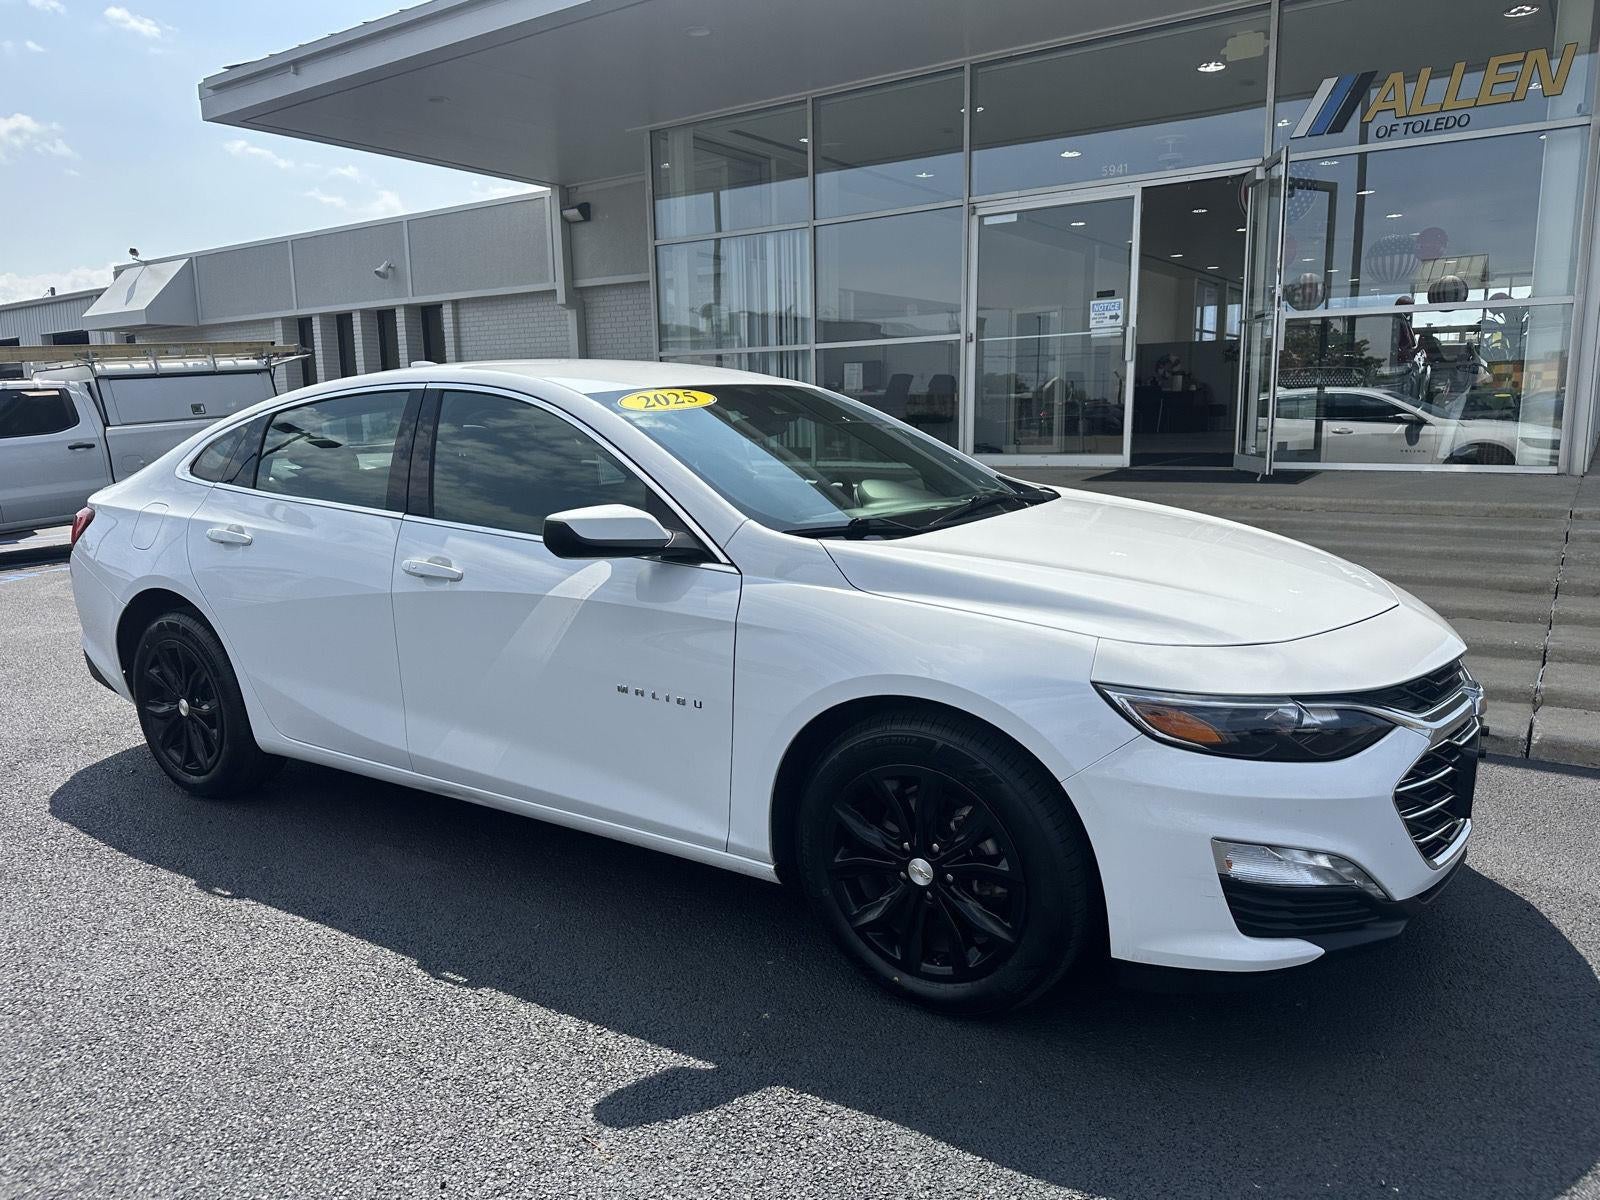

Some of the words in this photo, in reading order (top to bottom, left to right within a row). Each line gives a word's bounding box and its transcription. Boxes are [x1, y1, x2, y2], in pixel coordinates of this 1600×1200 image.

[1361, 42, 1578, 123] ALLEN
[1375, 122, 1400, 139] OF
[1402, 113, 1471, 135] TOLEDO
[1092, 302, 1120, 312] NOTICE
[637, 391, 698, 409] 2025
[616, 684, 703, 709] MALIBU
